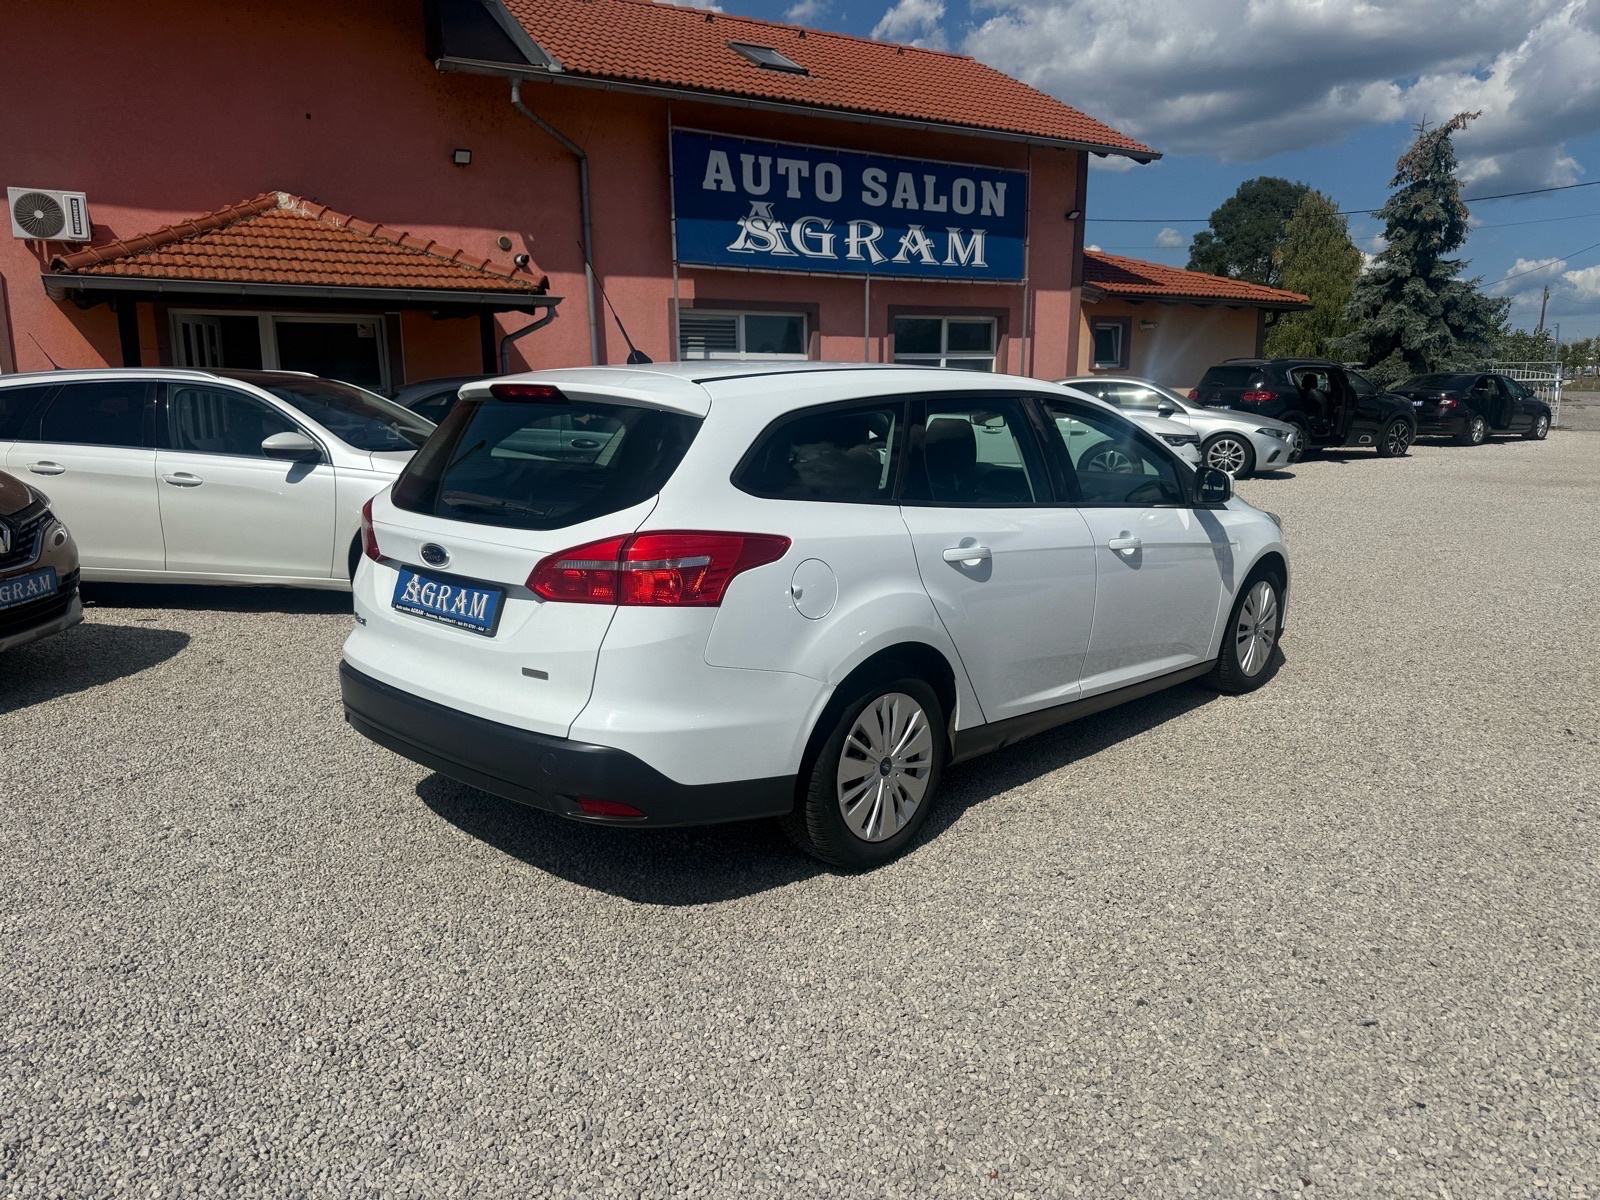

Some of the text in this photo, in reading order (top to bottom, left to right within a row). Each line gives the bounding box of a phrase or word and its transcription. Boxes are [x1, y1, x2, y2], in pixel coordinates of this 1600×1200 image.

[702, 150, 1007, 217] AUTO SALON
[72, 200, 81, 233] HEINNER
[0, 574, 51, 602] GRAM
